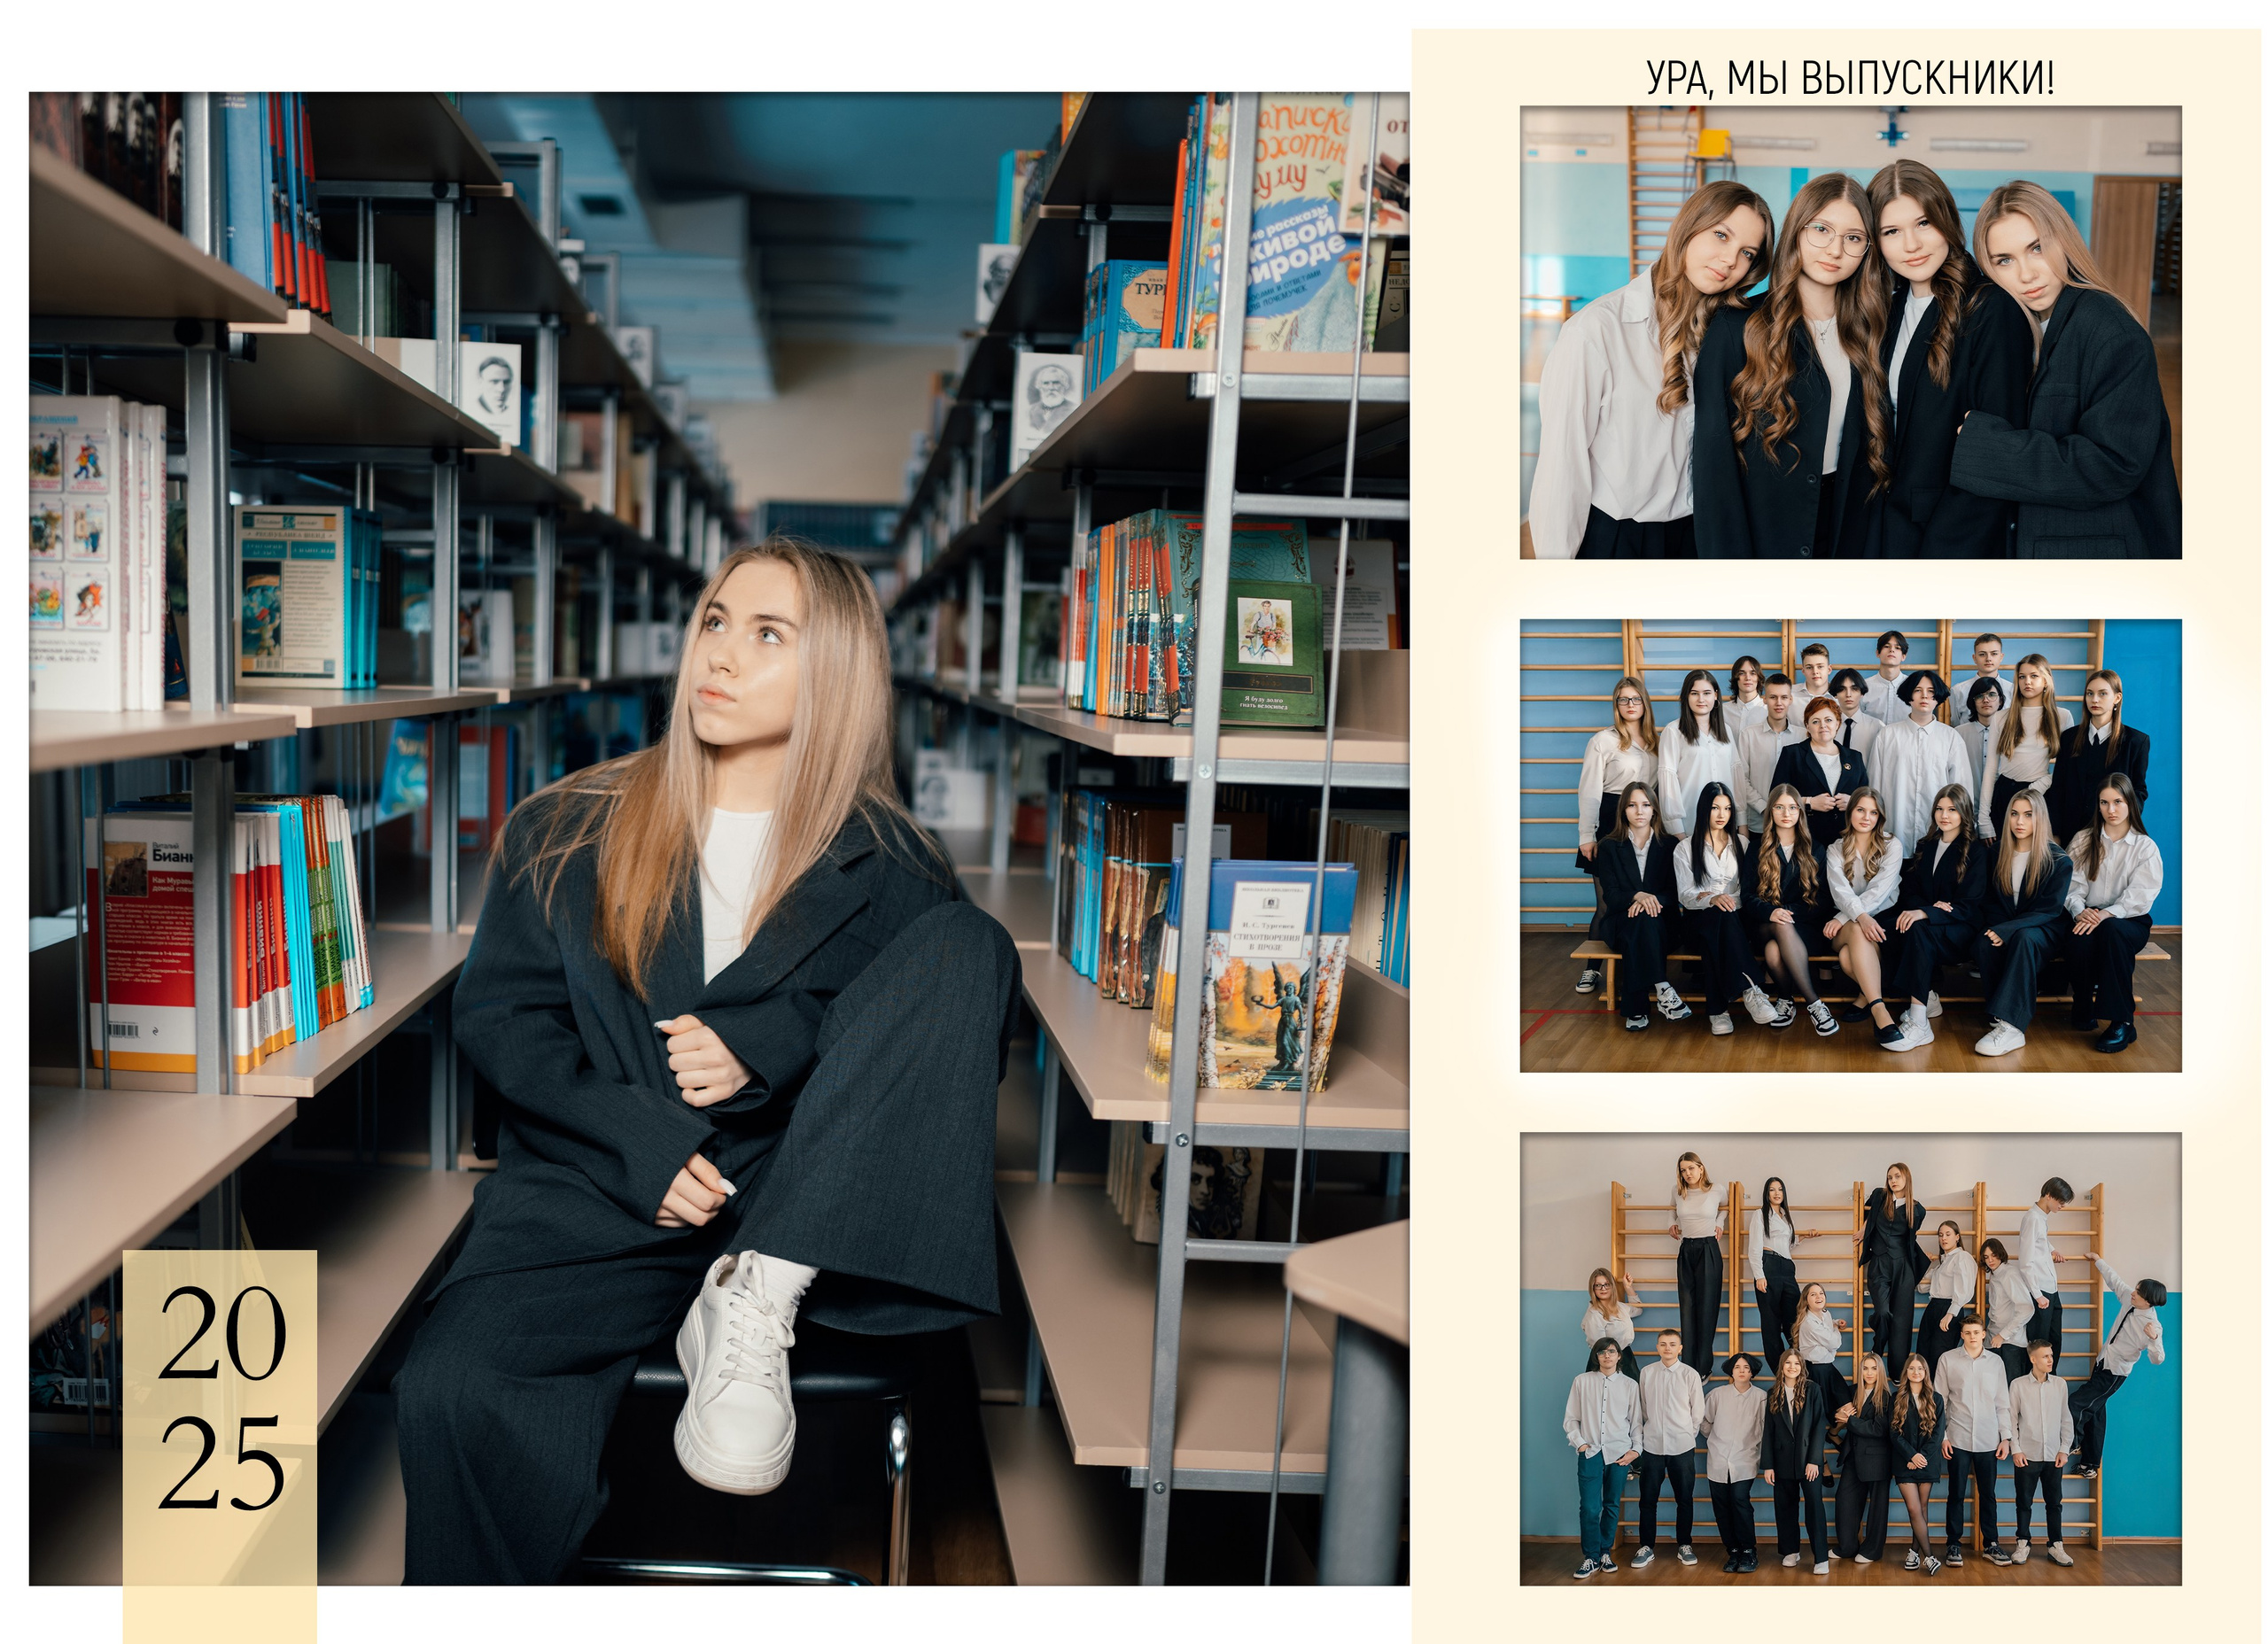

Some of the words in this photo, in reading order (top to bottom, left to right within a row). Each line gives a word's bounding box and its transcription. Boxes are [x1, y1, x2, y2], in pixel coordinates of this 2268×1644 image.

[1257, 103, 1350, 136] аписк
[1254, 164, 1307, 200] уму
[1266, 205, 1329, 238] рассказы
[1262, 284, 1308, 306] ПОЧЕМУЧЕК
[167, 877, 194, 886] Муравь
[257, 900, 266, 958] Бианки
[1233, 933, 1301, 942] СТИХОТВОРЕНИЯ
